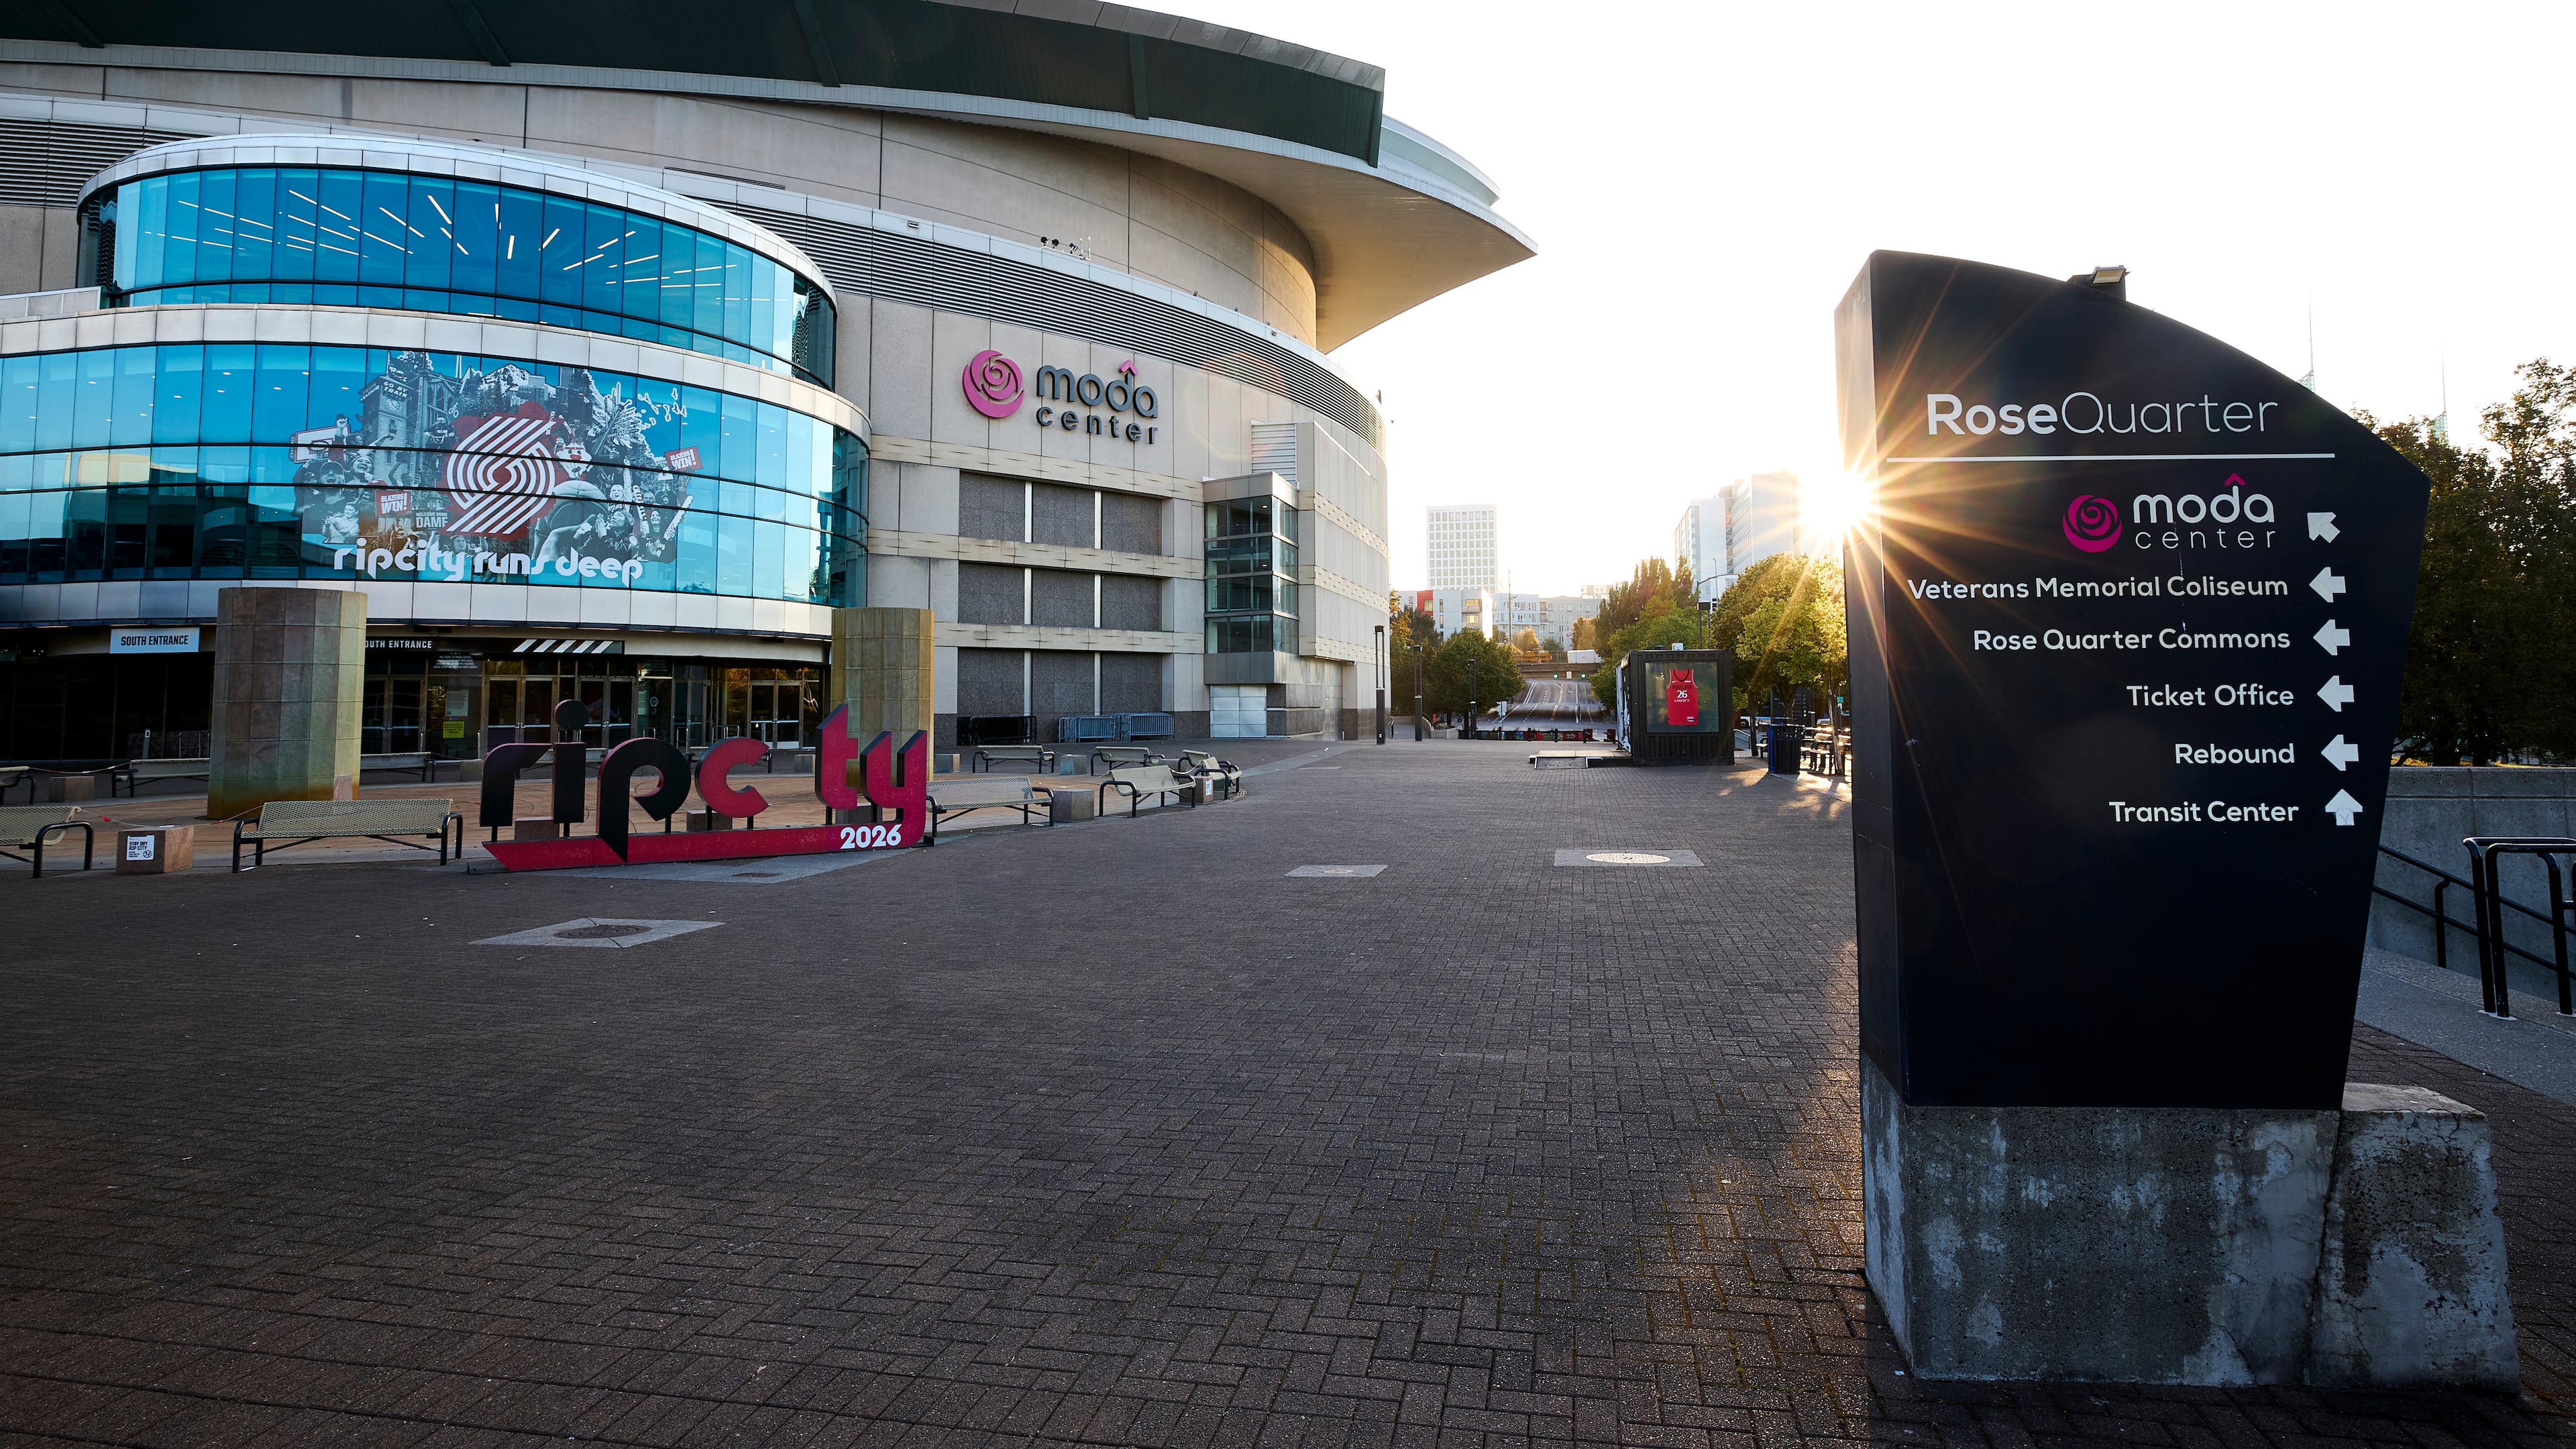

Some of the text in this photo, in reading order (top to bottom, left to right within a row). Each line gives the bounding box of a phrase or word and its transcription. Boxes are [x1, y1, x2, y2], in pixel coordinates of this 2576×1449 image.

[384, 386, 408, 398] TRAIN
[1036, 362, 1159, 419] moda
[1036, 407, 1159, 445] center
[380, 493, 404, 502] BLAZERS
[2133, 474, 2275, 523] moda
[2135, 528, 2276, 549] center
[472, 551, 549, 575] runs
[555, 547, 643, 589] deep
[1907, 576, 2288, 599] Veterans Memorial Coliseum
[121, 635, 189, 646] SOUTH ENTRANCE
[364, 640, 432, 649] OUTH ENTRANCE
[1974, 628, 2290, 650] Rose Quarter Commons
[1676, 690, 1688, 698] 26
[2126, 683, 2294, 706] Ticket Office
[2175, 743, 2295, 764] Rebound
[2108, 800, 2300, 822] Transit Center
[840, 824, 902, 849] 2026
